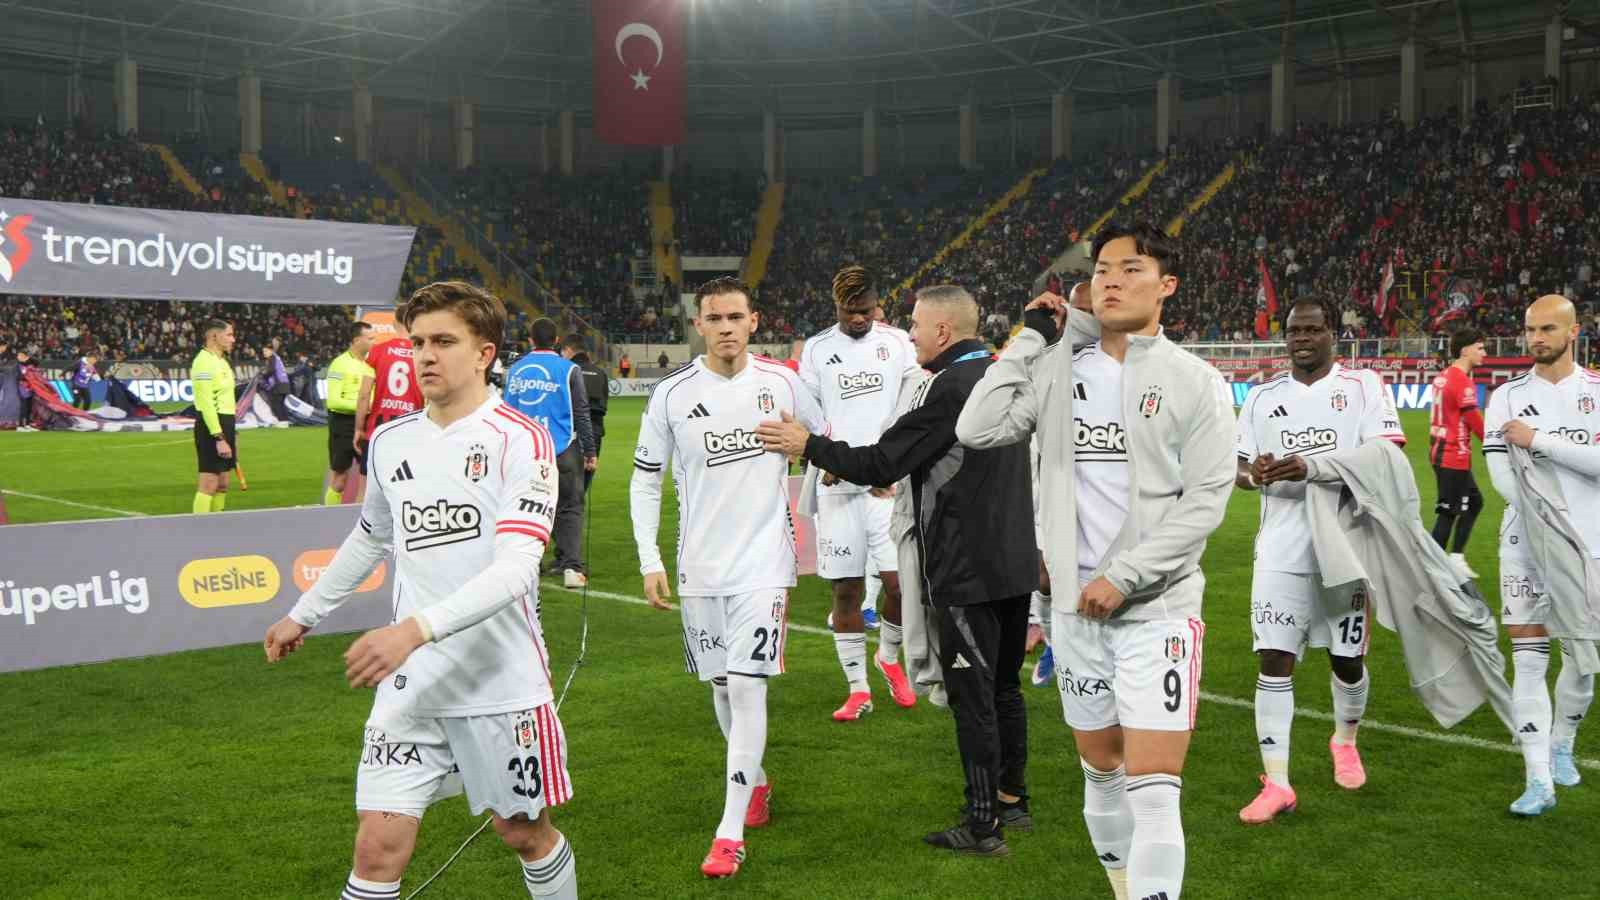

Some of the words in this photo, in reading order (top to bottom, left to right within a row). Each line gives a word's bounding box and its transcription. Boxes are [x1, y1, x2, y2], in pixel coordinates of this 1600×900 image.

[42, 226, 224, 276] trendyol
[228, 236, 353, 285] süperLig
[388, 360, 410, 397] 6
[838, 371, 884, 391] beko
[1073, 417, 1127, 451] bek
[1281, 427, 1338, 450] beko
[402, 499, 481, 533] beko
[0, 570, 150, 625] üperLig
[1256, 610, 1296, 625] URKA
[1338, 616, 1363, 645] 15
[750, 627, 778, 662] 23
[1060, 678, 1112, 697] URKA
[1164, 669, 1181, 712] 9
[363, 742, 423, 766] URKA
[508, 755, 541, 799] 33
